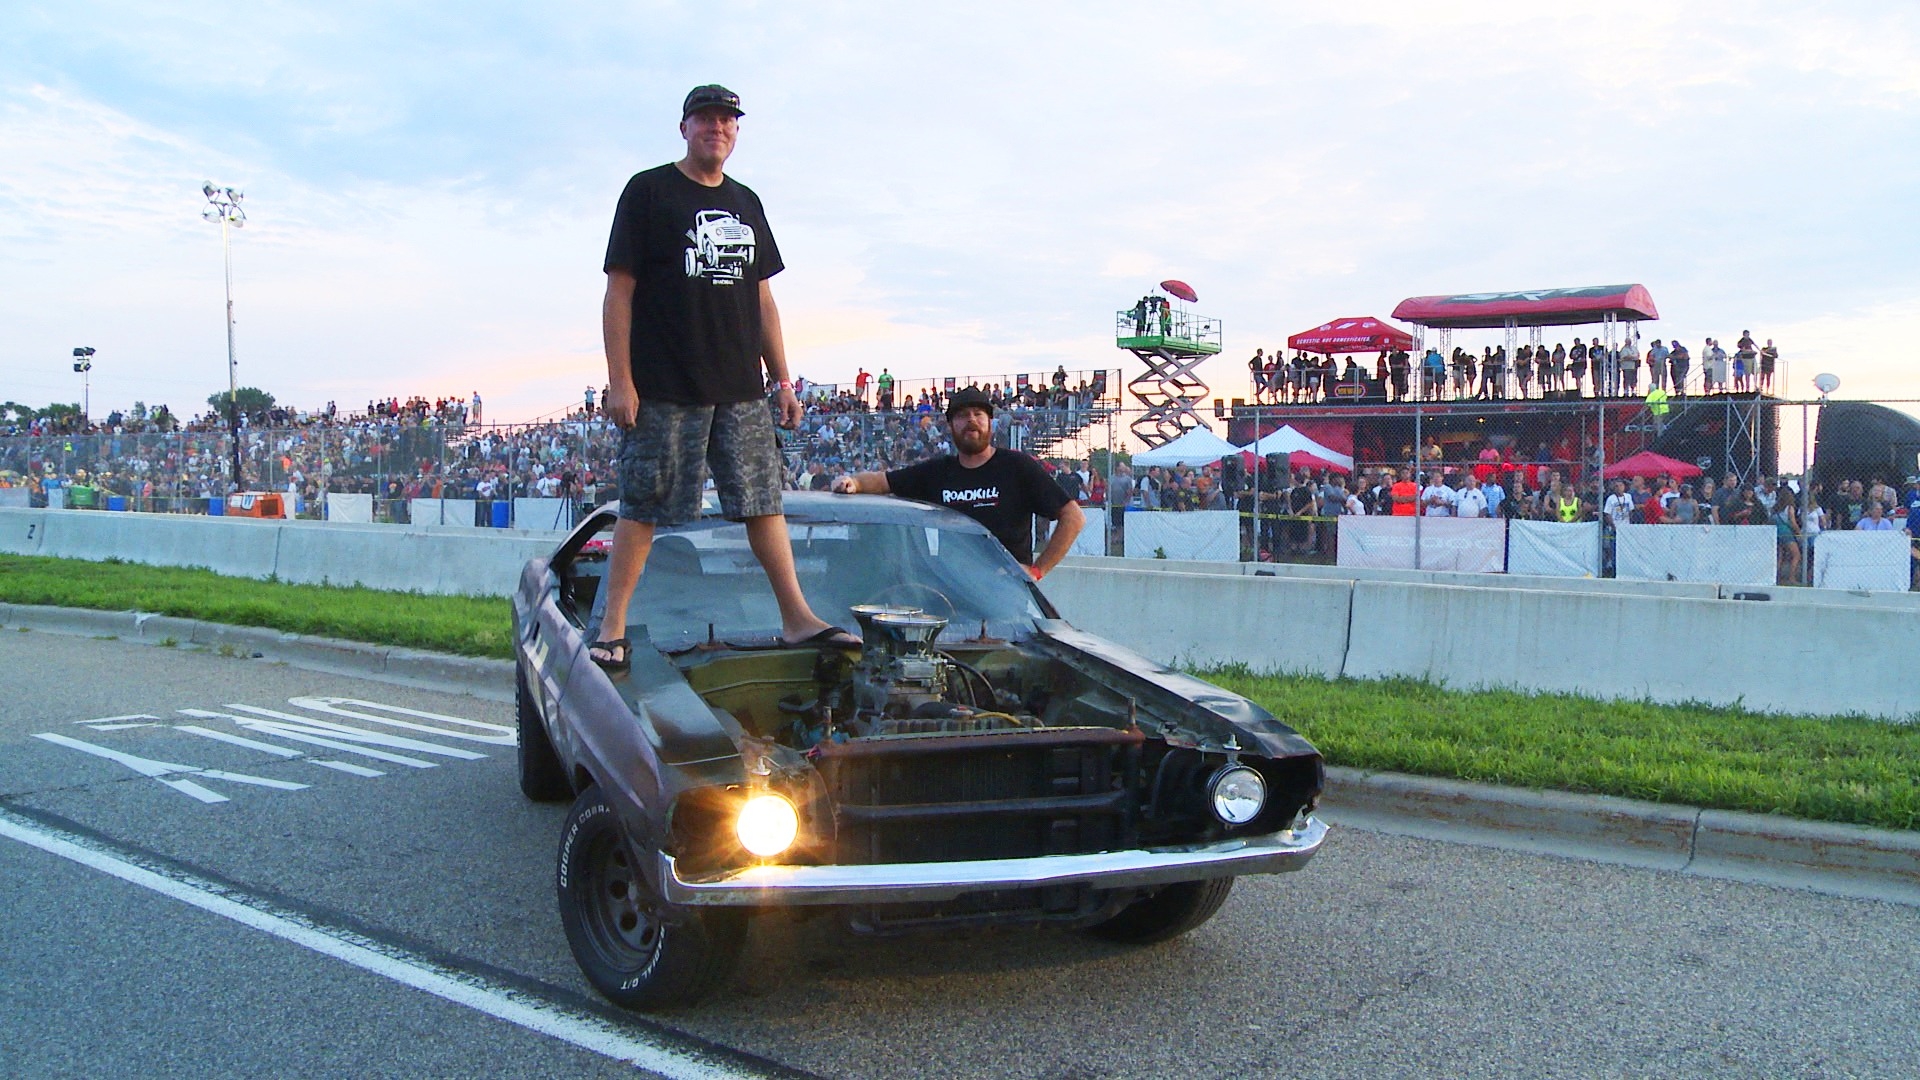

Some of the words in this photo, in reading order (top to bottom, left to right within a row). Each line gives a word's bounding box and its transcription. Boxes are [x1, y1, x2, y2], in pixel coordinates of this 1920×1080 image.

[942, 486, 999, 503] ROADKILL
[27, 523, 36, 540] 2
[559, 822, 579, 889] COOPER
[578, 804, 611, 825] COBRA
